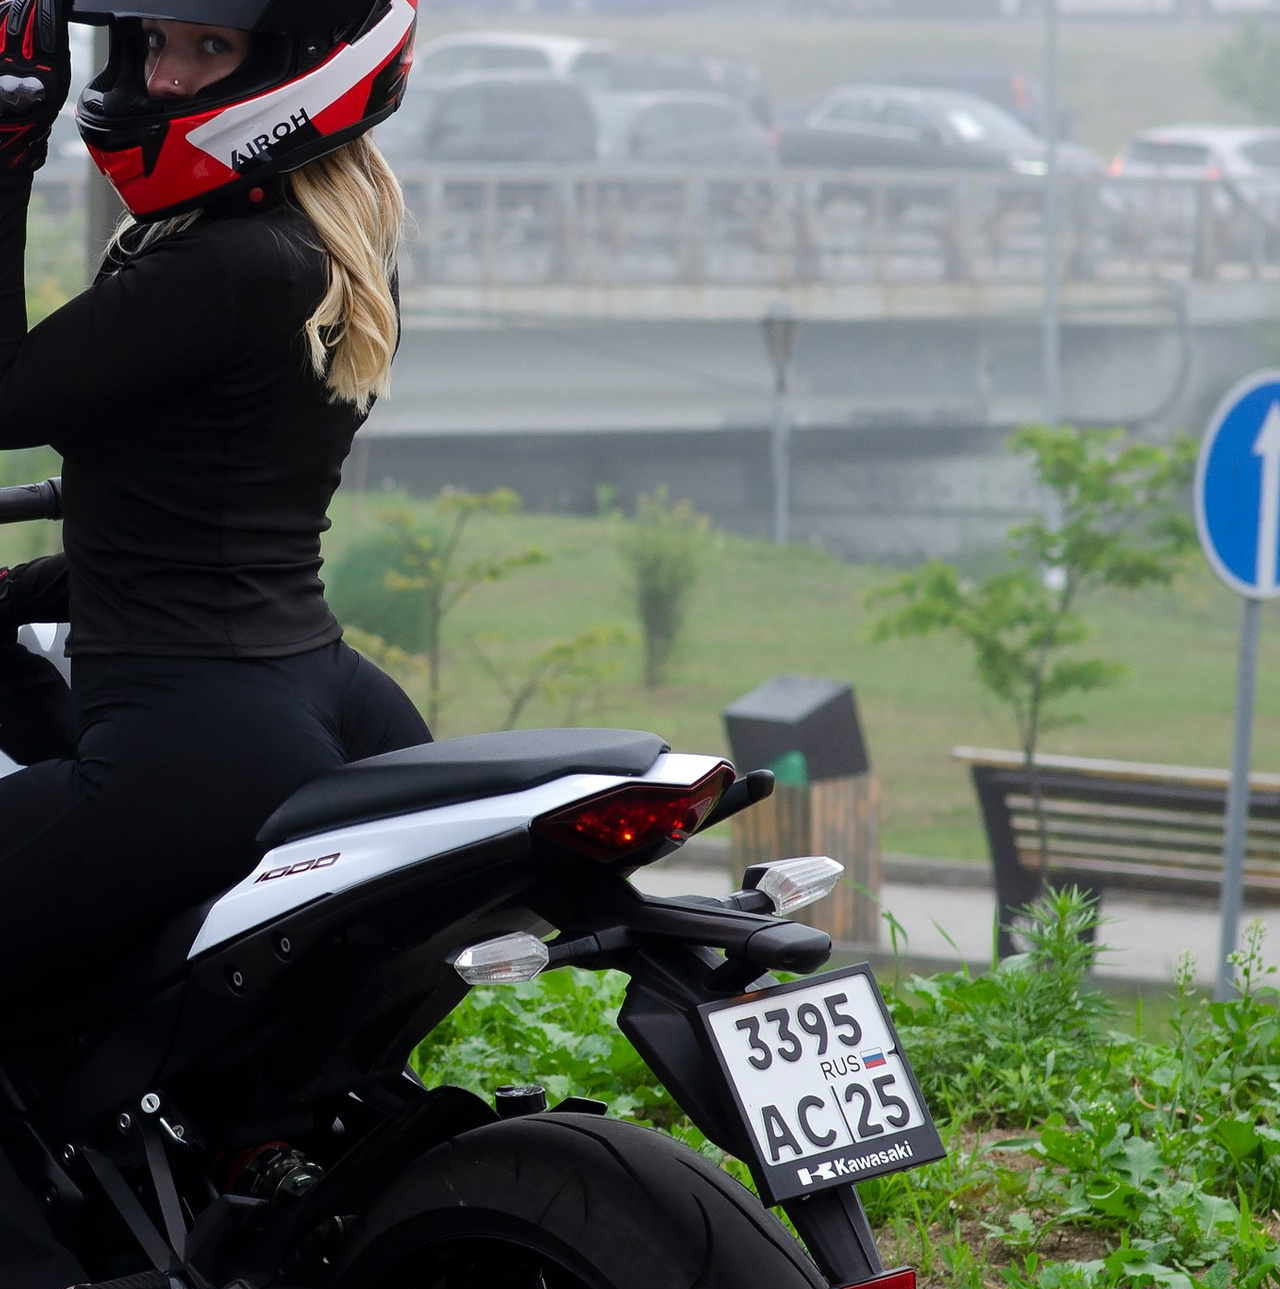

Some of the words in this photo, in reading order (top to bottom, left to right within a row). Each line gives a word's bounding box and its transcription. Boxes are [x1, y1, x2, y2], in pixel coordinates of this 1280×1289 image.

[231, 107, 311, 173] AIROH
[253, 852, 341, 884] 1000
[735, 992, 862, 1070] 3395
[820, 1055, 861, 1081] RUS
[761, 1095, 837, 1161] AC
[844, 1074, 911, 1138] 25
[835, 1140, 914, 1177] Kawasaki
